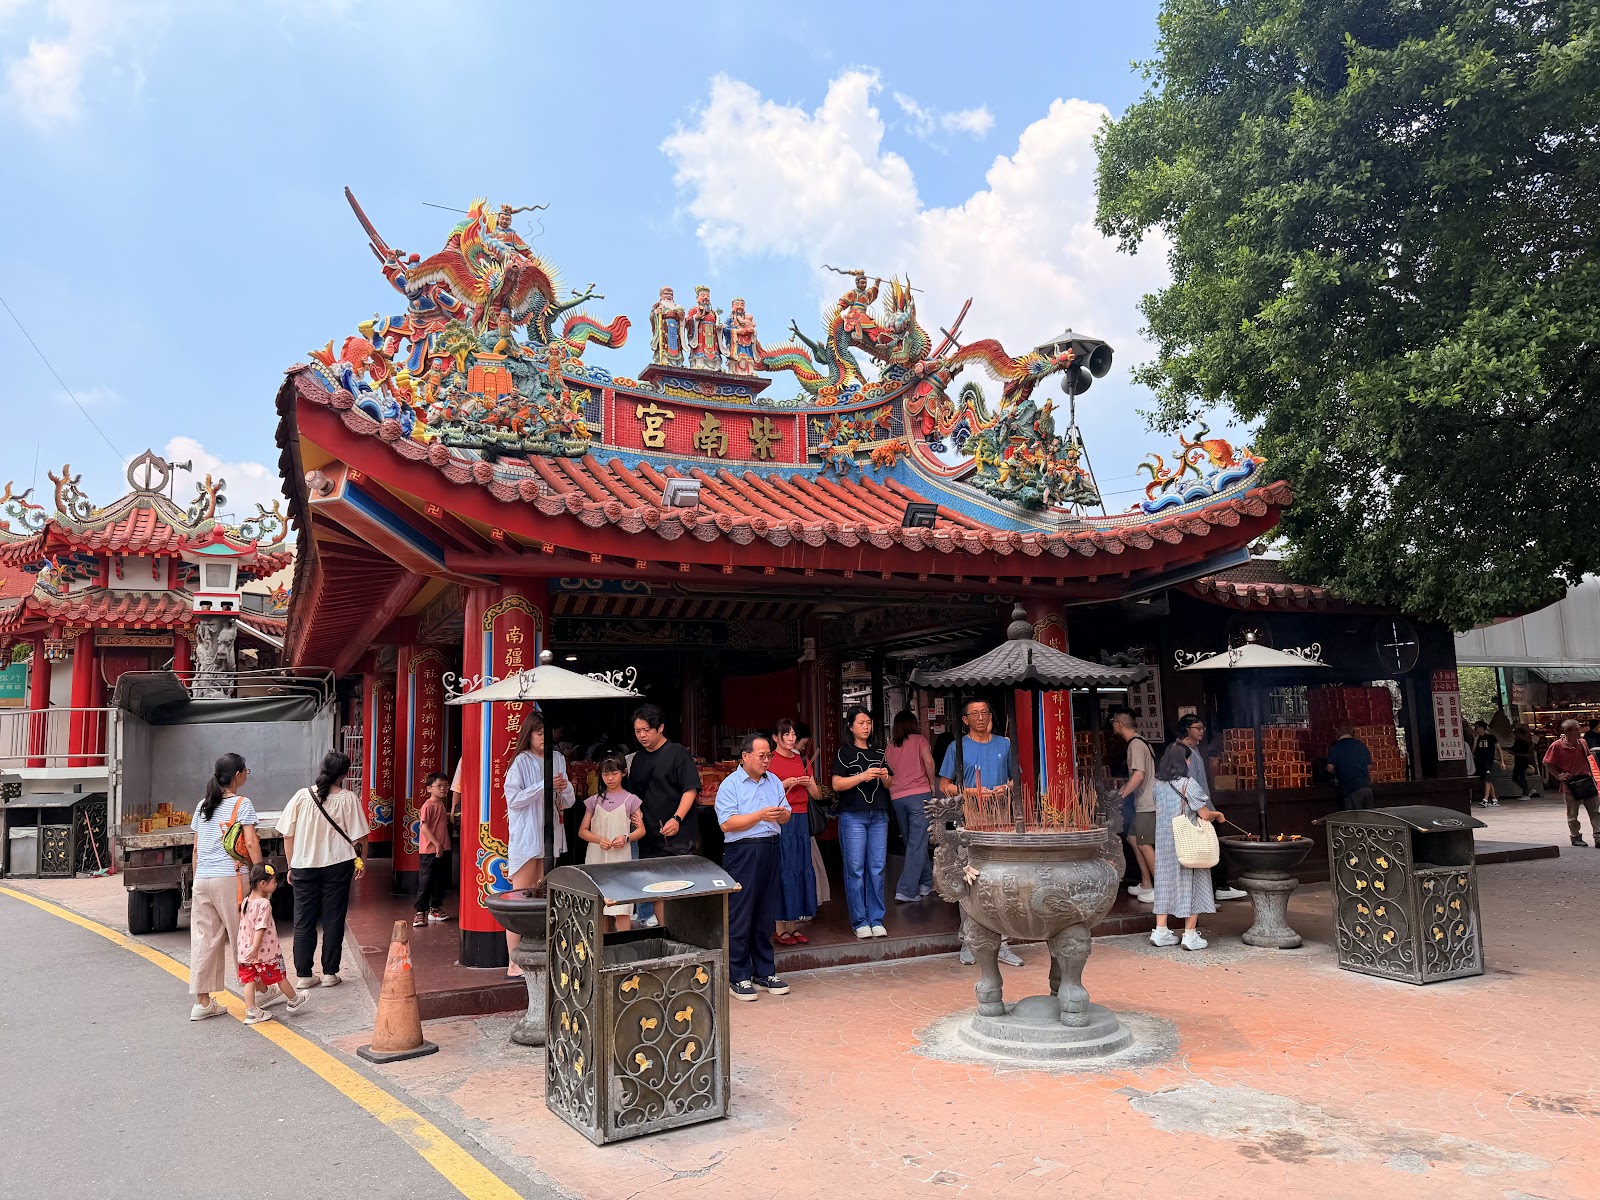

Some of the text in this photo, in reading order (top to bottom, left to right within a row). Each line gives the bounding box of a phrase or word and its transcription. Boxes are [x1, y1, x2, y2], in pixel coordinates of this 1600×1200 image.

[636, 402, 783, 460] 紫南宮
[1433, 682, 1457, 690] 小心扒手
[1436, 696, 1446, 738] 功德無量
[1449, 696, 1459, 737] 香銀隨意
